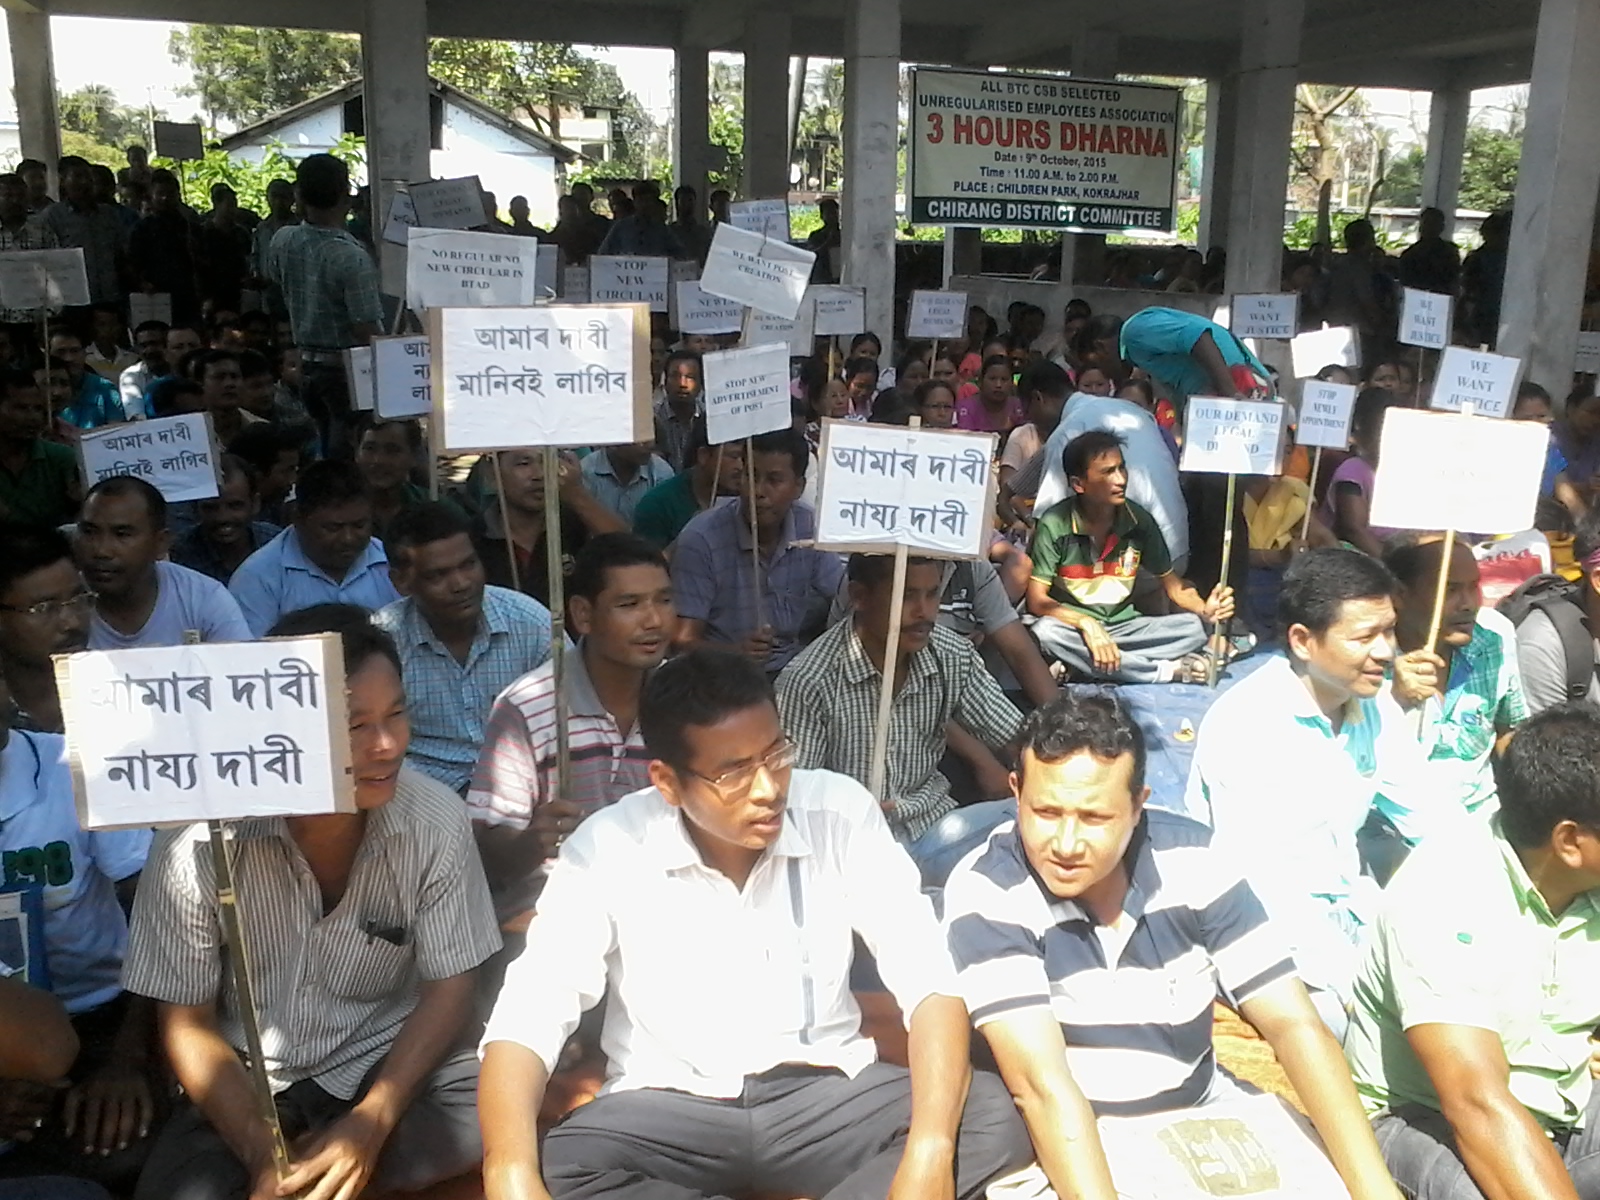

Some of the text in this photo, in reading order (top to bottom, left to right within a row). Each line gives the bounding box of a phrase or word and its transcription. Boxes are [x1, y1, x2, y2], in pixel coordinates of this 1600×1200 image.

[980, 80, 1121, 102] ALL BTC CSB SELECTED
[919, 94, 1175, 124] UNREGULARISED EMPLOYEES ASSOCIATION
[927, 113, 1169, 158] 3 HOURS DHARNA
[994, 151, 1017, 163] Date
[1040, 154, 1081, 169] October,
[1083, 156, 1107, 168] 2015
[980, 166, 1005, 178] Time
[1014, 168, 1040, 180] 11.00
[1066, 172, 1076, 182] to
[1079, 172, 1099, 183] 2.00
[953, 181, 988, 194] PLACE
[997, 183, 1048, 196] CHILDREN
[1051, 186, 1080, 199] PARK,
[1083, 188, 1140, 201] KOKRAJHAR
[927, 201, 1162, 227] CHIRANG DISTRICT COMMITTEE
[432, 249, 520, 263] NO REGULAR NO
[426, 263, 524, 278] NEW CIRCULAR IN
[614, 261, 648, 272] STOP
[738, 264, 781, 283] CREATION
[461, 280, 490, 290] BTAD
[616, 275, 644, 286] NEW
[596, 290, 664, 303] CIRCULAR
[1258, 300, 1274, 308] WE
[1420, 300, 1433, 311] WE
[1249, 313, 1280, 321] WANT
[1414, 315, 1436, 327] WANT
[558, 320, 610, 350] দাবী
[1245, 326, 1289, 334] JUSTICE
[1470, 360, 1491, 374] WE
[456, 364, 627, 397] মানিবই লাগিব
[725, 375, 767, 390] STOP NEW
[1457, 376, 1495, 393] WANT
[711, 385, 779, 405] ADVERTISEMENT
[1318, 389, 1337, 400] STOP
[730, 402, 763, 415] OF POST
[1195, 408, 1279, 424] OUR DEMAND
[1312, 402, 1339, 414] NEWLY
[1301, 416, 1347, 430] APPOINTMENT
[157, 422, 191, 444] দাবী
[160, 450, 208, 472] লাগিব
[831, 445, 987, 486] আমাৰ দাবী
[909, 500, 969, 537] দাবী
[226, 657, 319, 710] দাবী
[211, 734, 304, 788] দাবী
